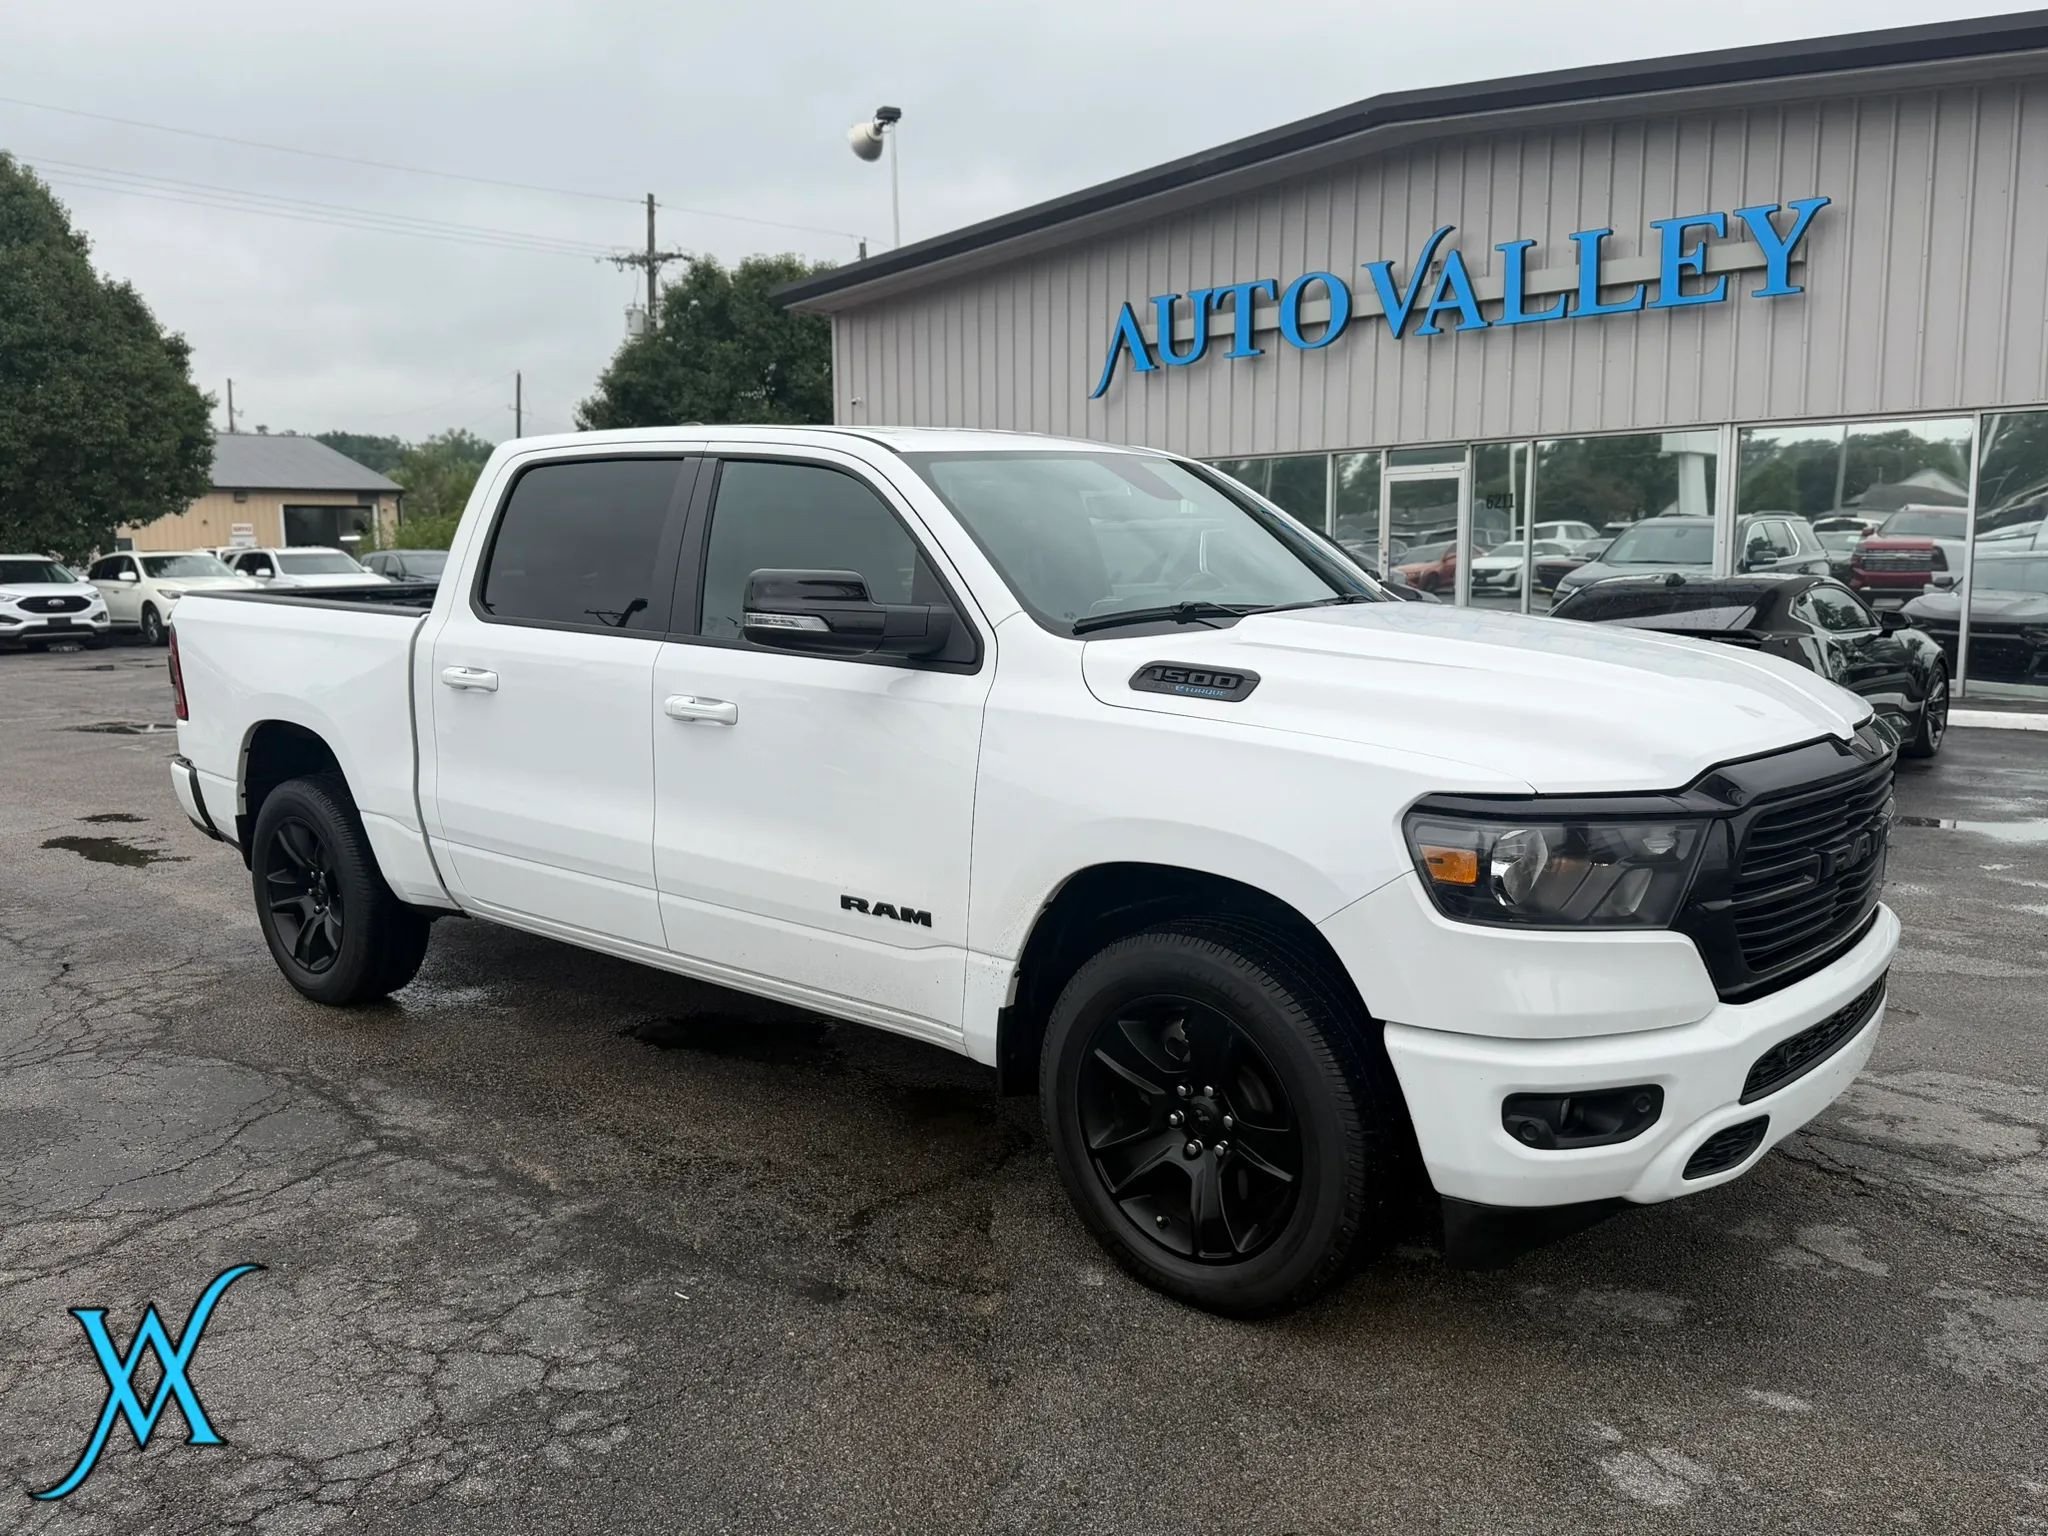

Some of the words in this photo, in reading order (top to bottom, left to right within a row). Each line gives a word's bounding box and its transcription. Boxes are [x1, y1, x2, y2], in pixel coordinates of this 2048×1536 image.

[1088, 271, 1352, 400] AUTO
[1362, 196, 1831, 340] VALLEY
[1486, 492, 1514, 510] 6211
[1151, 666, 1239, 689] 1500
[840, 894, 932, 928] RAM
